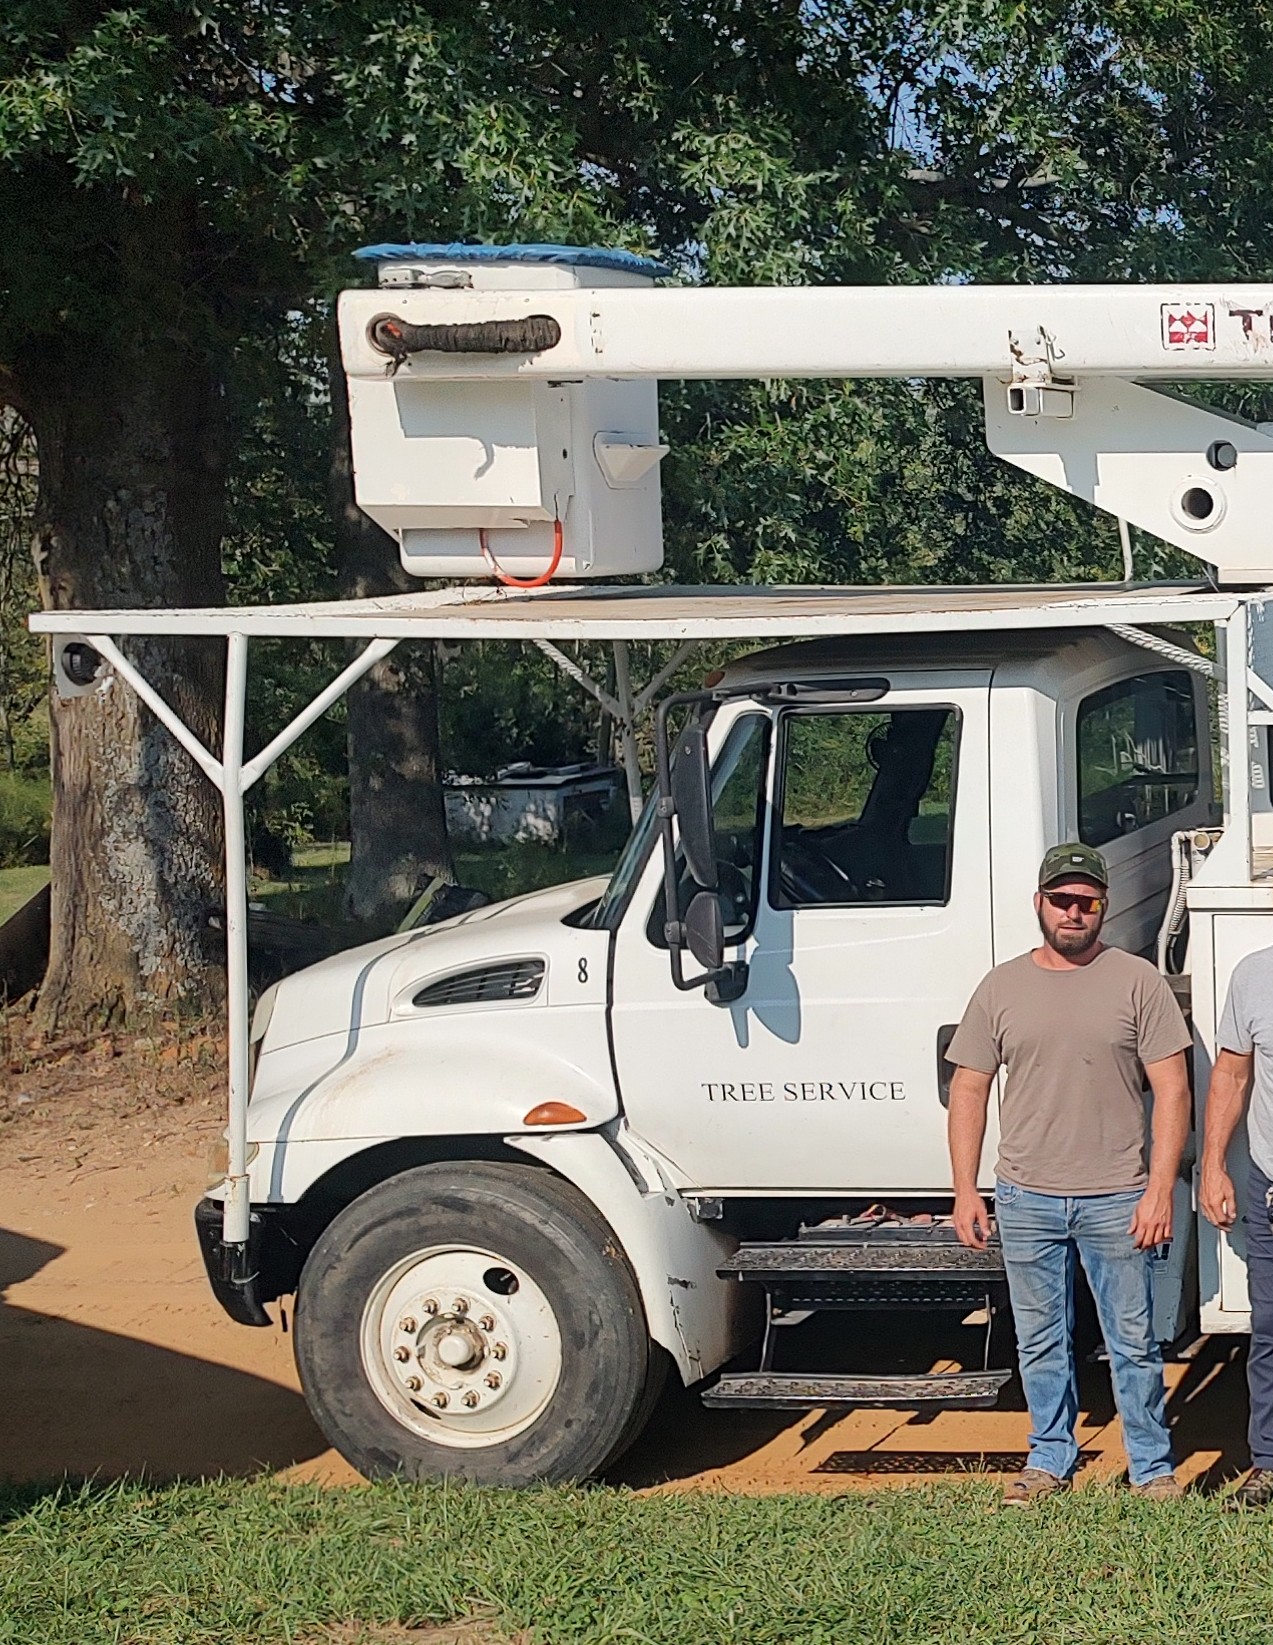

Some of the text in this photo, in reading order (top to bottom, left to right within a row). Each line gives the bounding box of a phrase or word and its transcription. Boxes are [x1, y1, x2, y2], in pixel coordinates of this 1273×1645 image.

[577, 956, 589, 984] 8
[701, 1080, 906, 1102] TREE SERVICE
